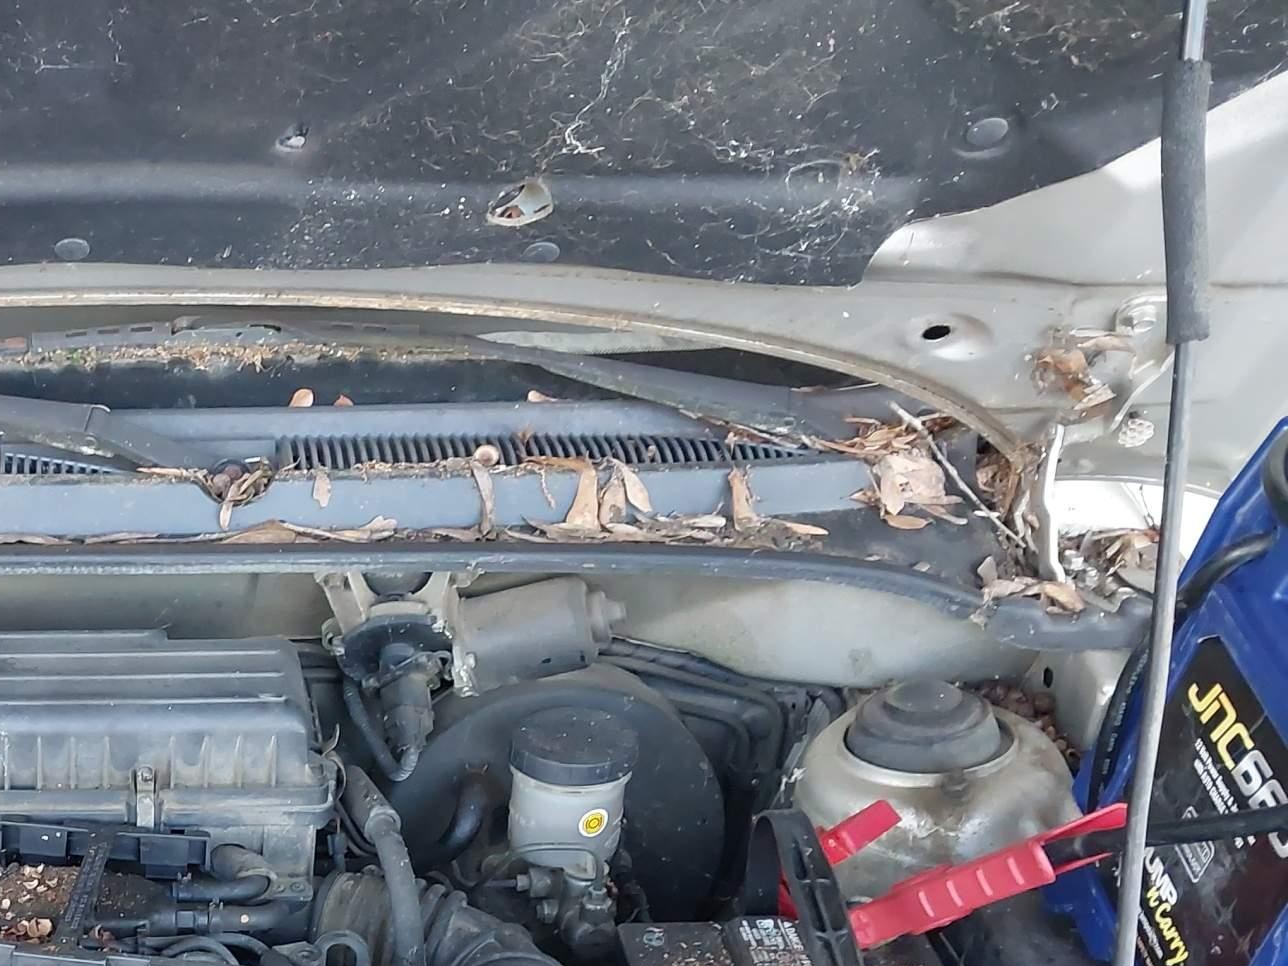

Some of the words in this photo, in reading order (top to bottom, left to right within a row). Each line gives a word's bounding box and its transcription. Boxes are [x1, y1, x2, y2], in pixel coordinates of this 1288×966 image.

[1188, 683, 1288, 858] JNC66
[1144, 847, 1178, 906] UMP
[1155, 902, 1189, 966] Carry
